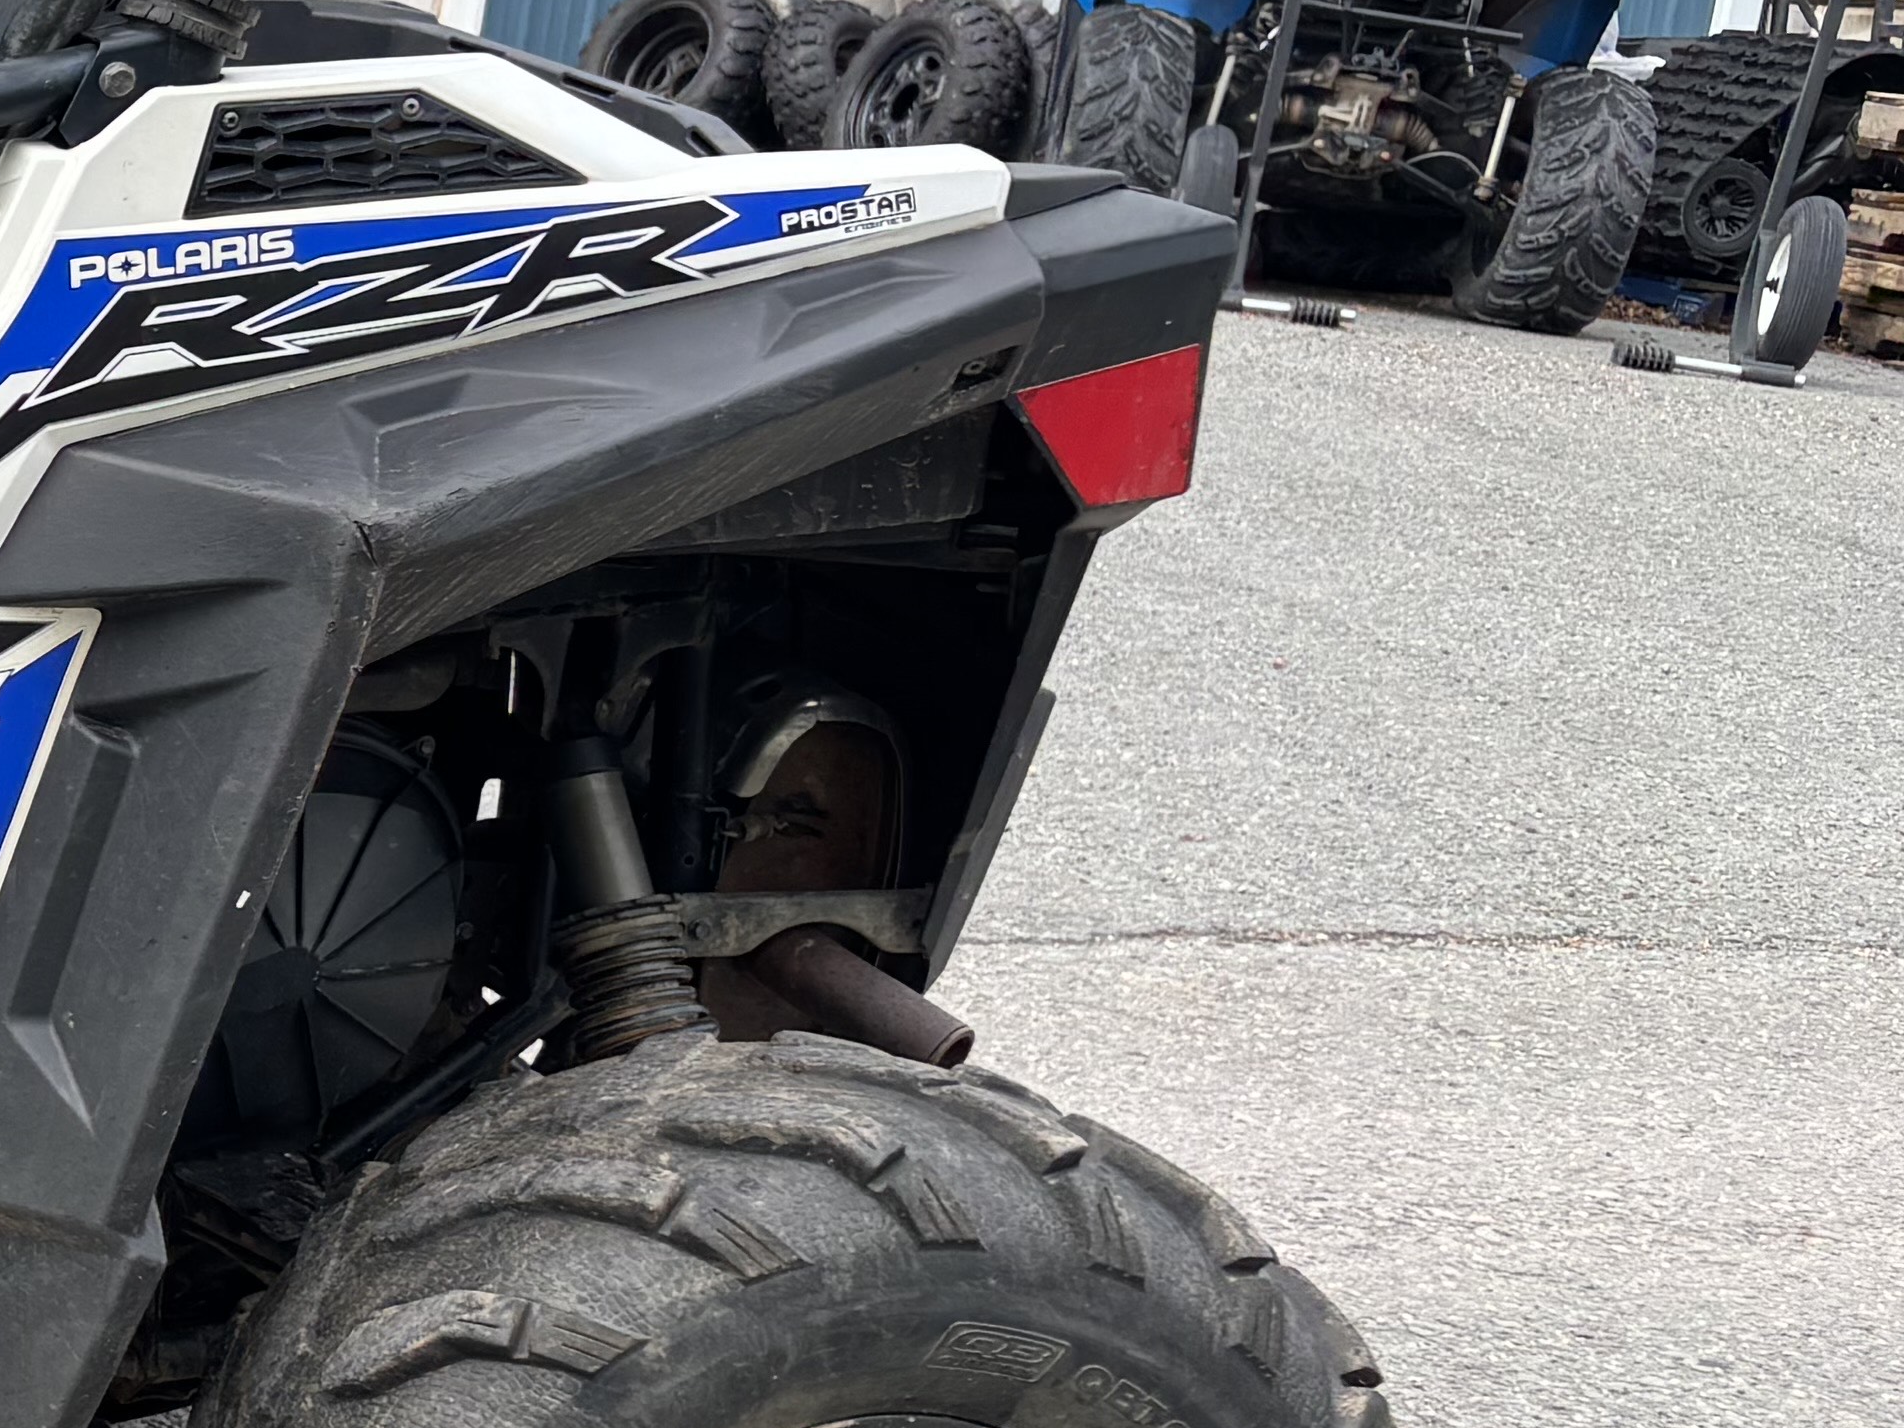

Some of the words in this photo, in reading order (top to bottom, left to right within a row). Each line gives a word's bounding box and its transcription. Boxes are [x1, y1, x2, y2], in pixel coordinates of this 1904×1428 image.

[780, 192, 914, 234] PROSTAR
[69, 227, 295, 289] POLARIS
[21, 195, 741, 410] RZR
